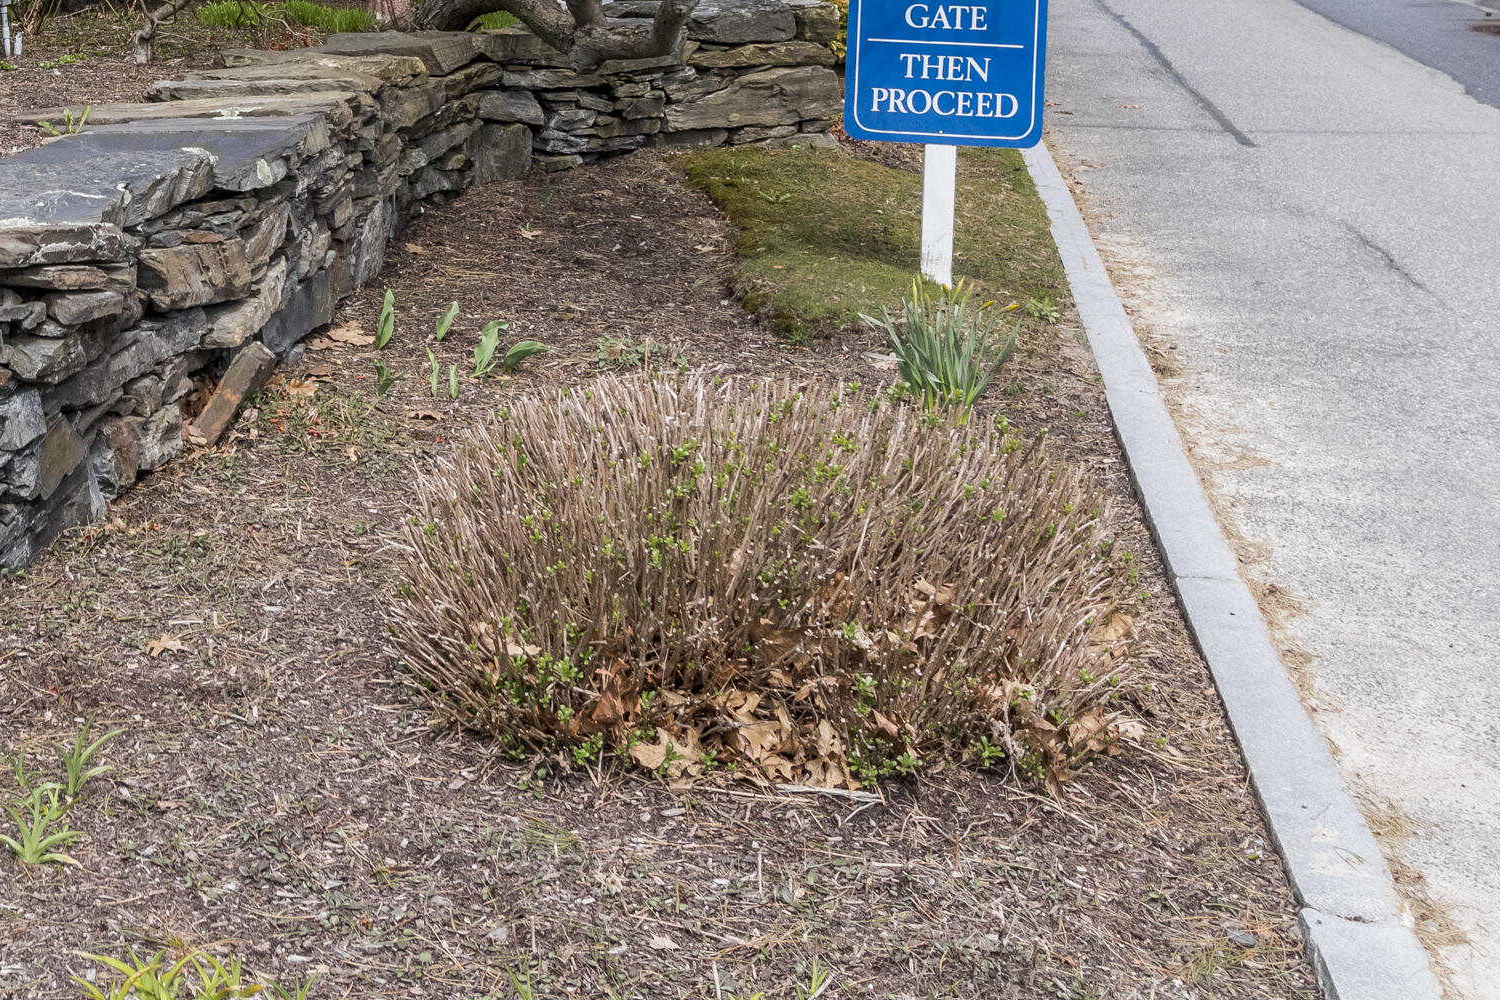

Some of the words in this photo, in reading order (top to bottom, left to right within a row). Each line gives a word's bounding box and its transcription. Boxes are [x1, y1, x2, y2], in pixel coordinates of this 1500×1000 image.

[904, 3, 988, 31] GATE
[899, 53, 992, 83] THEN
[870, 87, 1019, 118] PROCEED
